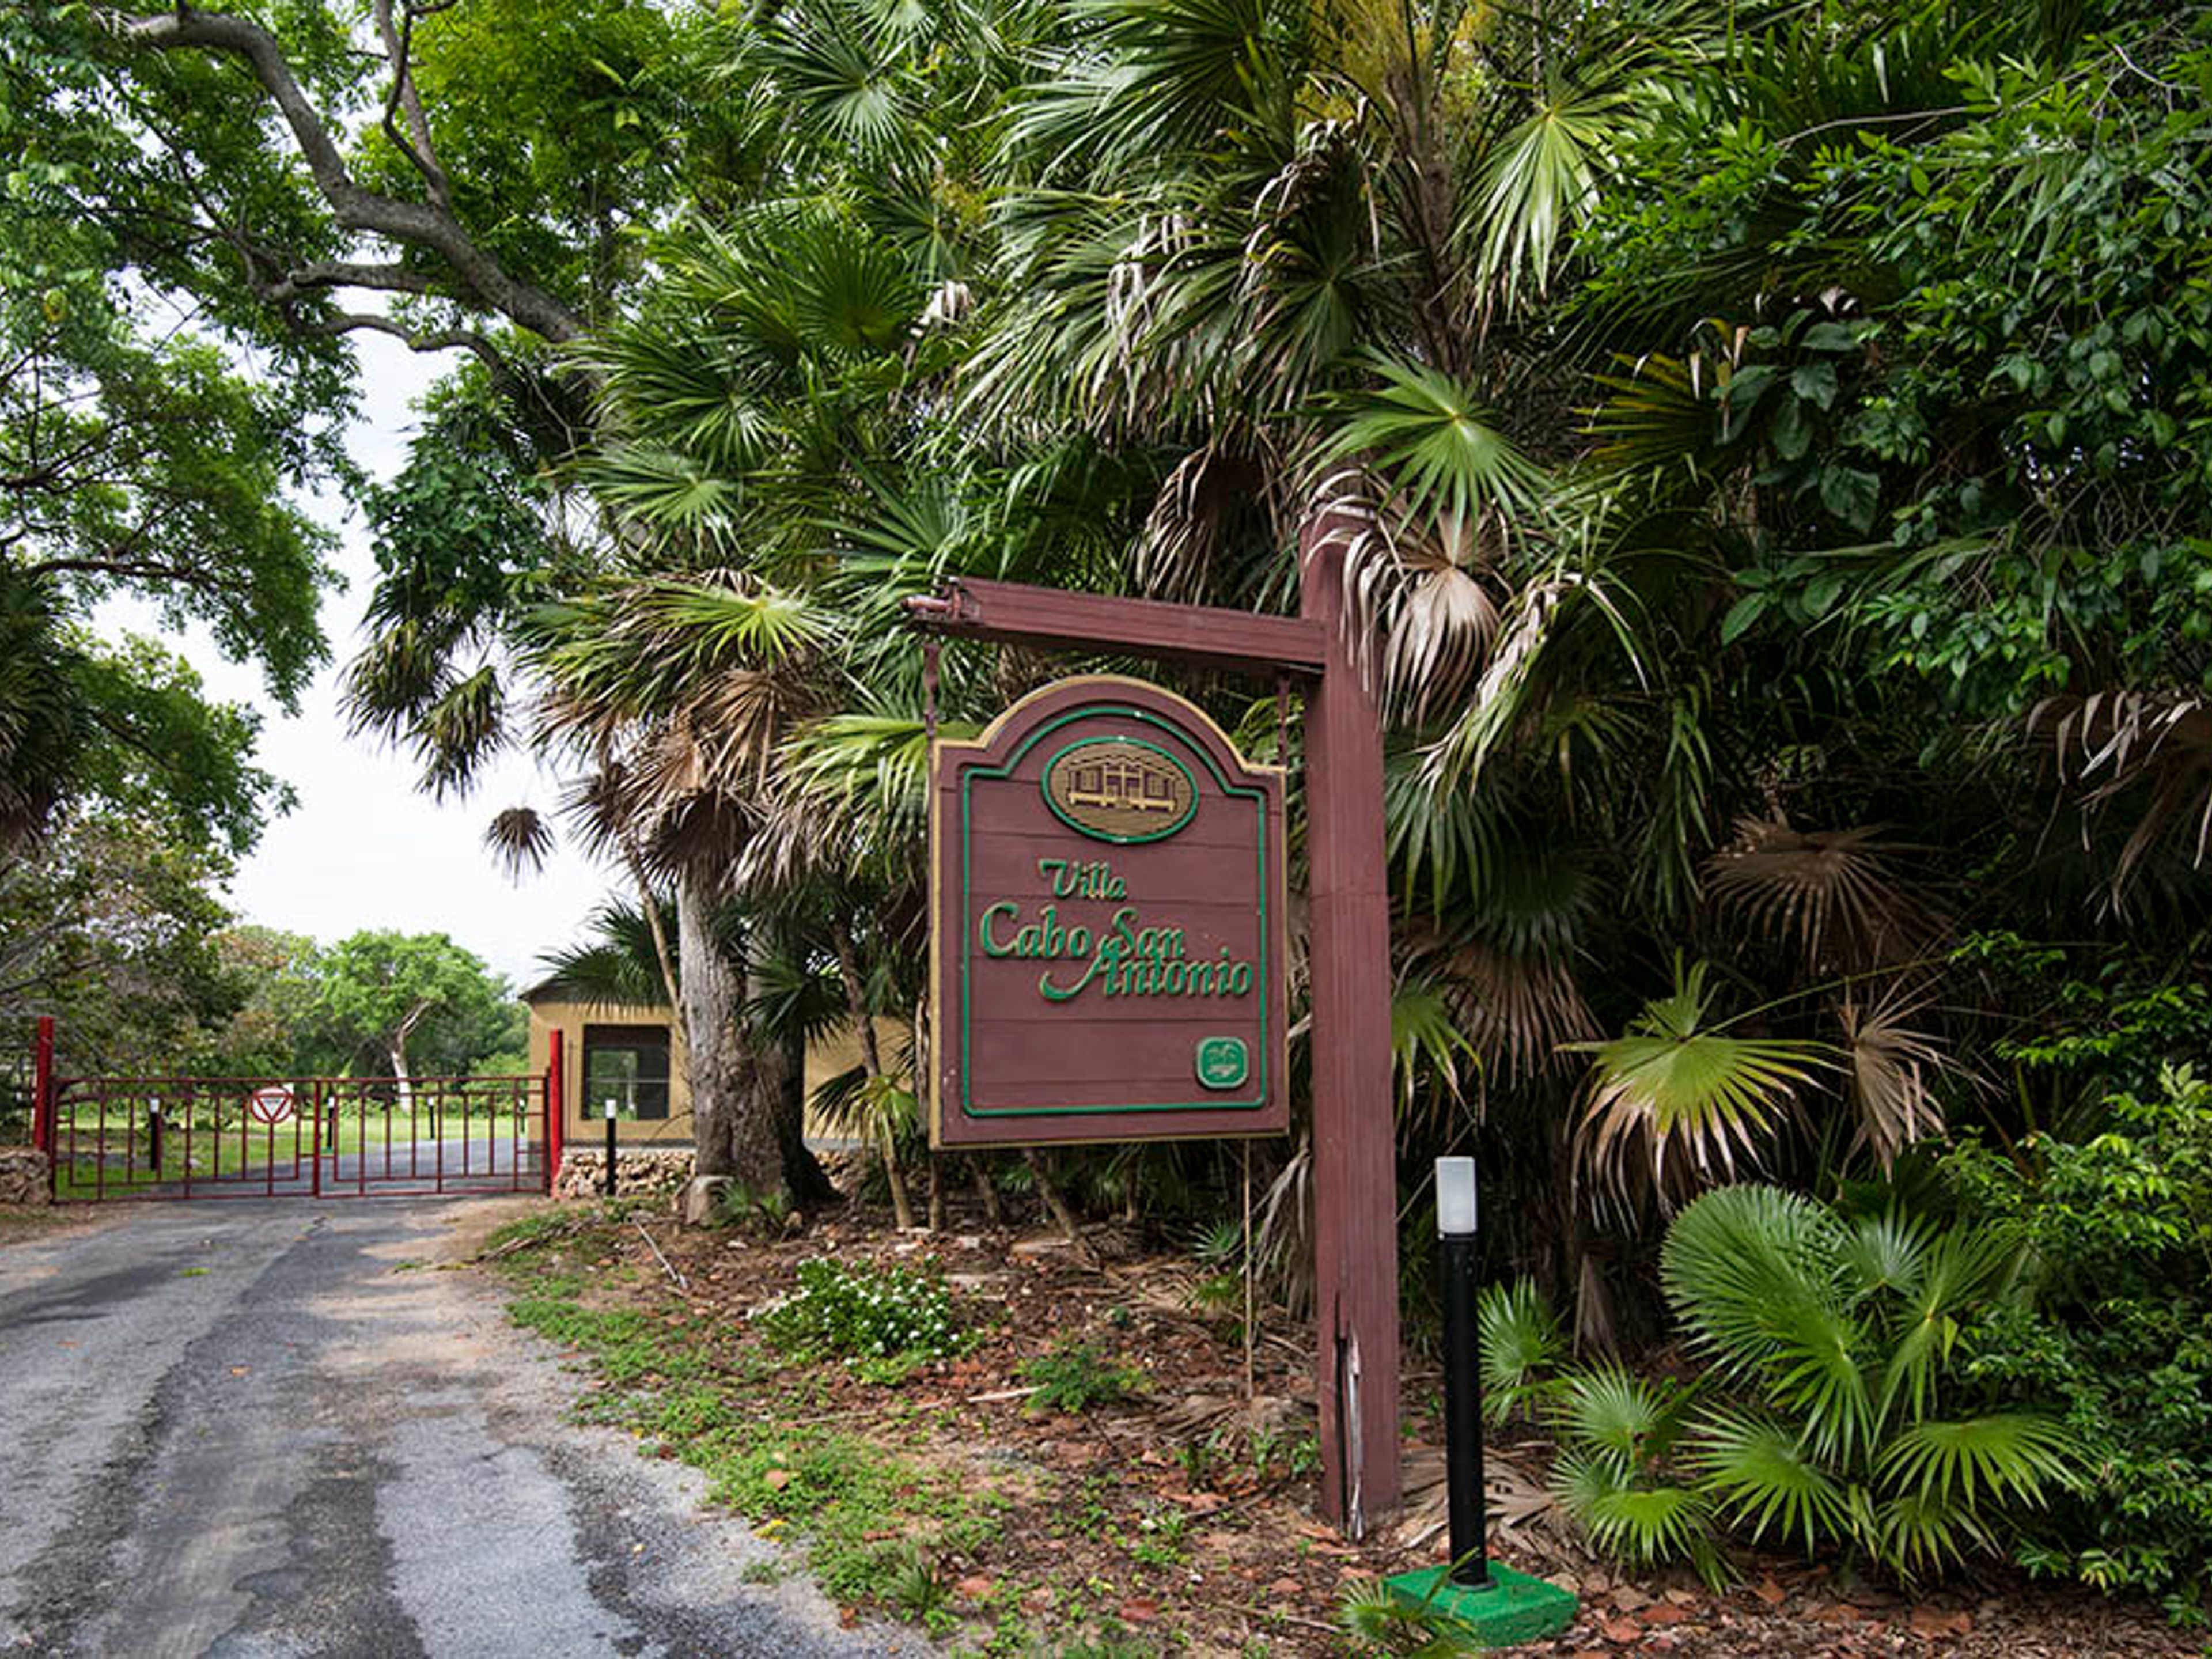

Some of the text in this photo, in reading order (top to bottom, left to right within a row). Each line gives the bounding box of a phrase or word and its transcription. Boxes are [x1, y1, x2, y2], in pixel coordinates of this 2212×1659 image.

[1039, 859, 1127, 899] Villa
[981, 902, 1185, 959] Cabo San
[1040, 946, 1252, 1000] Antonio
